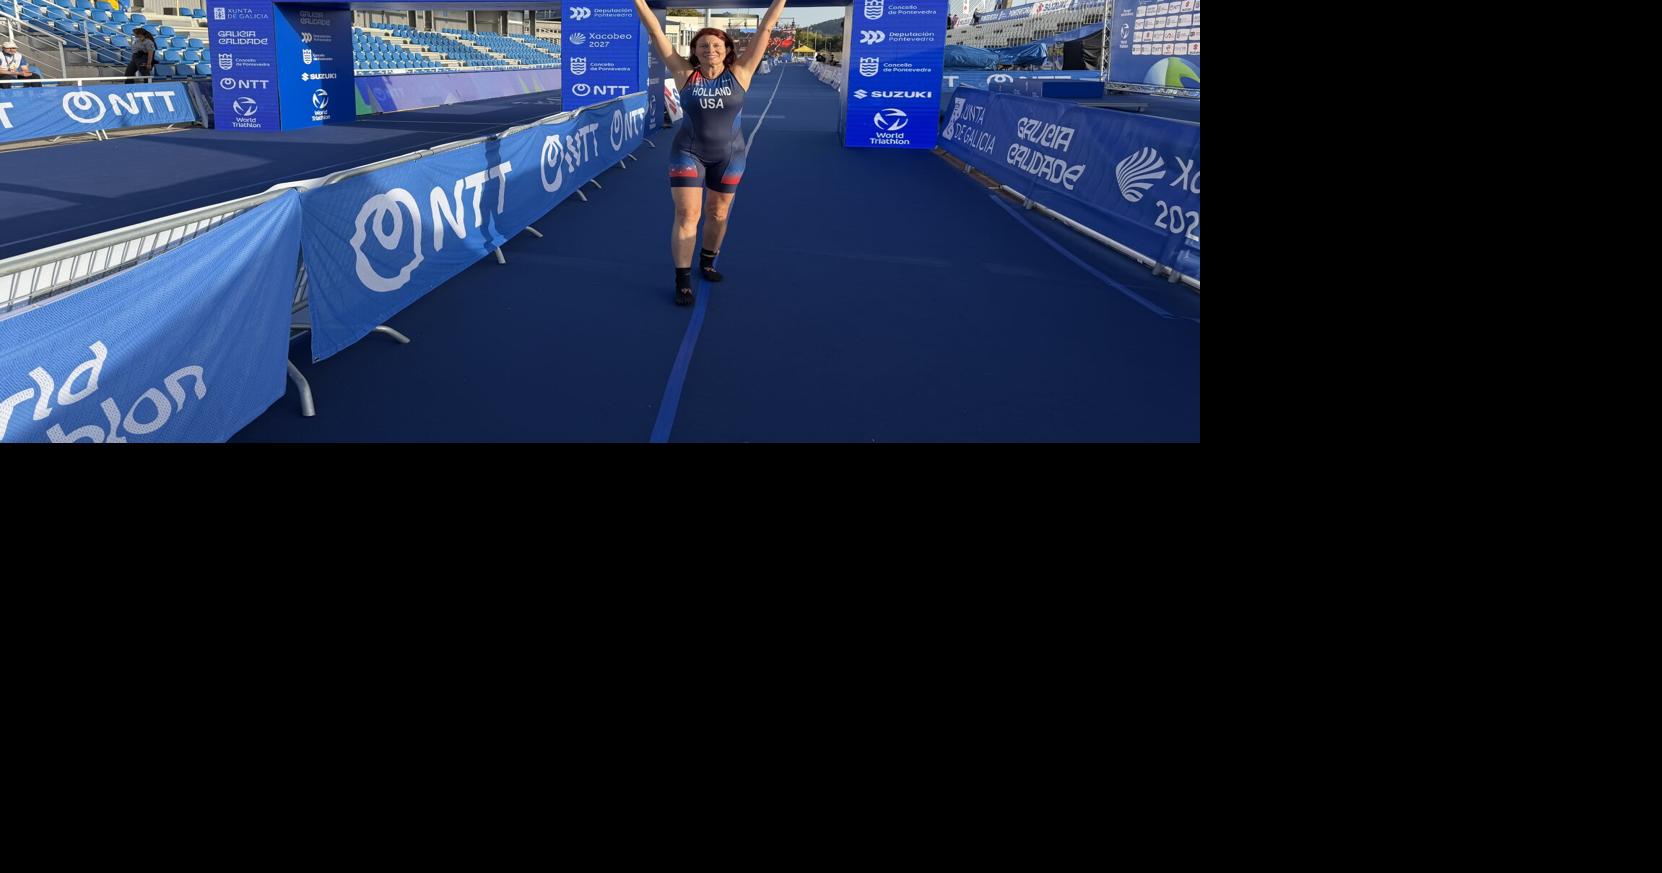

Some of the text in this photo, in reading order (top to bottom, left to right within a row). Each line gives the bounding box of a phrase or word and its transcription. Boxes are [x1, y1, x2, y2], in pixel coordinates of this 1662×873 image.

[217, 30, 256, 38] GALICIA
[588, 32, 632, 40] Xacobeo
[238, 80, 270, 89] NTT
[593, 86, 630, 95] NTT
[692, 86, 732, 97] HOLLAND
[108, 91, 175, 116] NTT
[700, 98, 724, 109] USA
[624, 107, 645, 141] NTT
[1017, 117, 1075, 152] GALICIA
[564, 122, 599, 173] NTT
[954, 123, 996, 154] DE GALICIA
[1006, 143, 1086, 190] CALIDADE
[430, 160, 512, 252] NTT
[1154, 200, 1200, 242] 202
